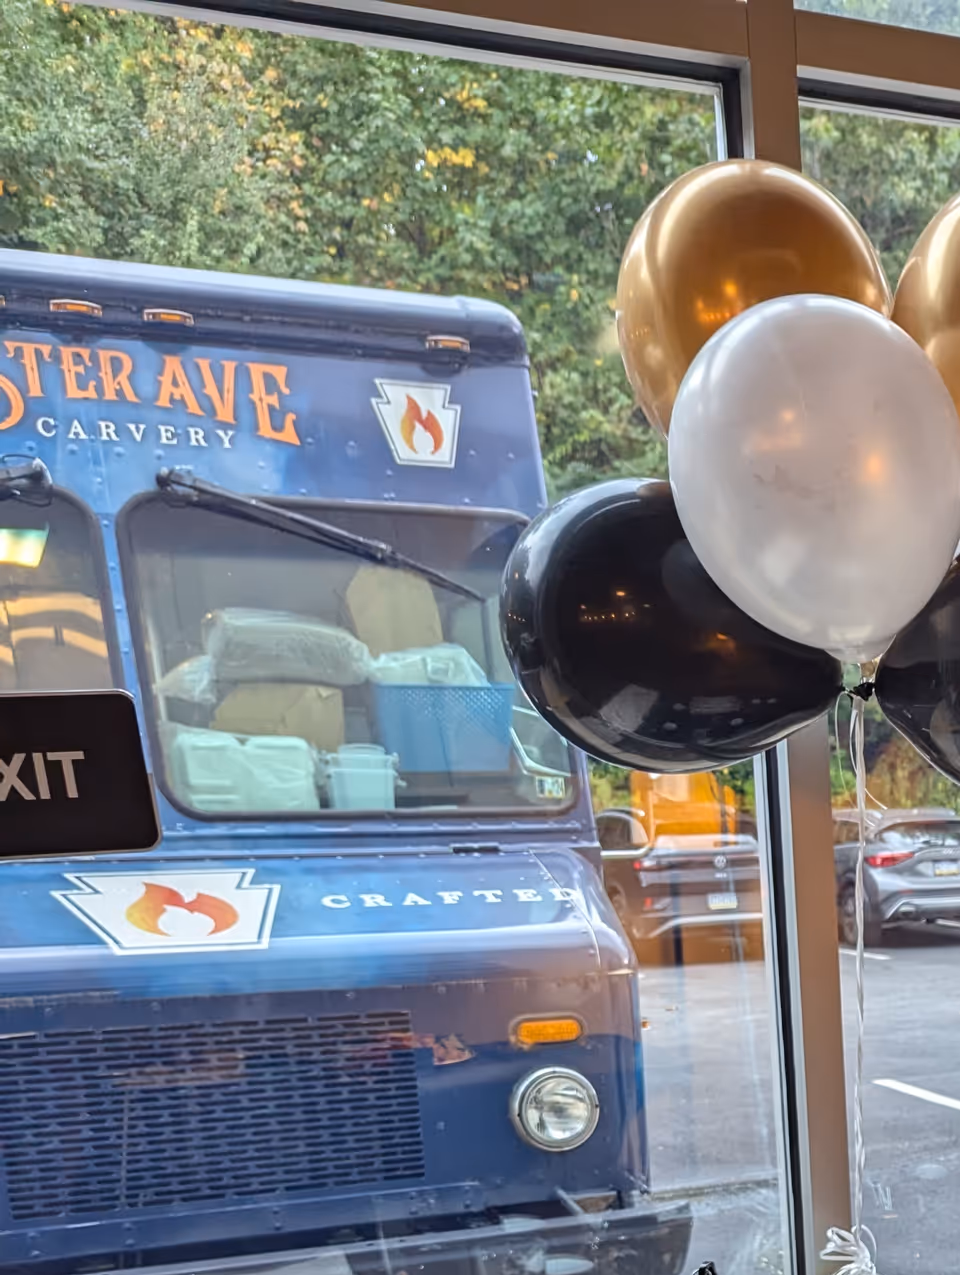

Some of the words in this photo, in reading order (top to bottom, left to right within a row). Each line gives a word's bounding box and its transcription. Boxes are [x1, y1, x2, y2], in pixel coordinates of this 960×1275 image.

[155, 355, 300, 445] AVE
[36, 417, 237, 449] CARVERY
[0, 750, 85, 802] XIT
[320, 888, 580, 909] CRAFTED
